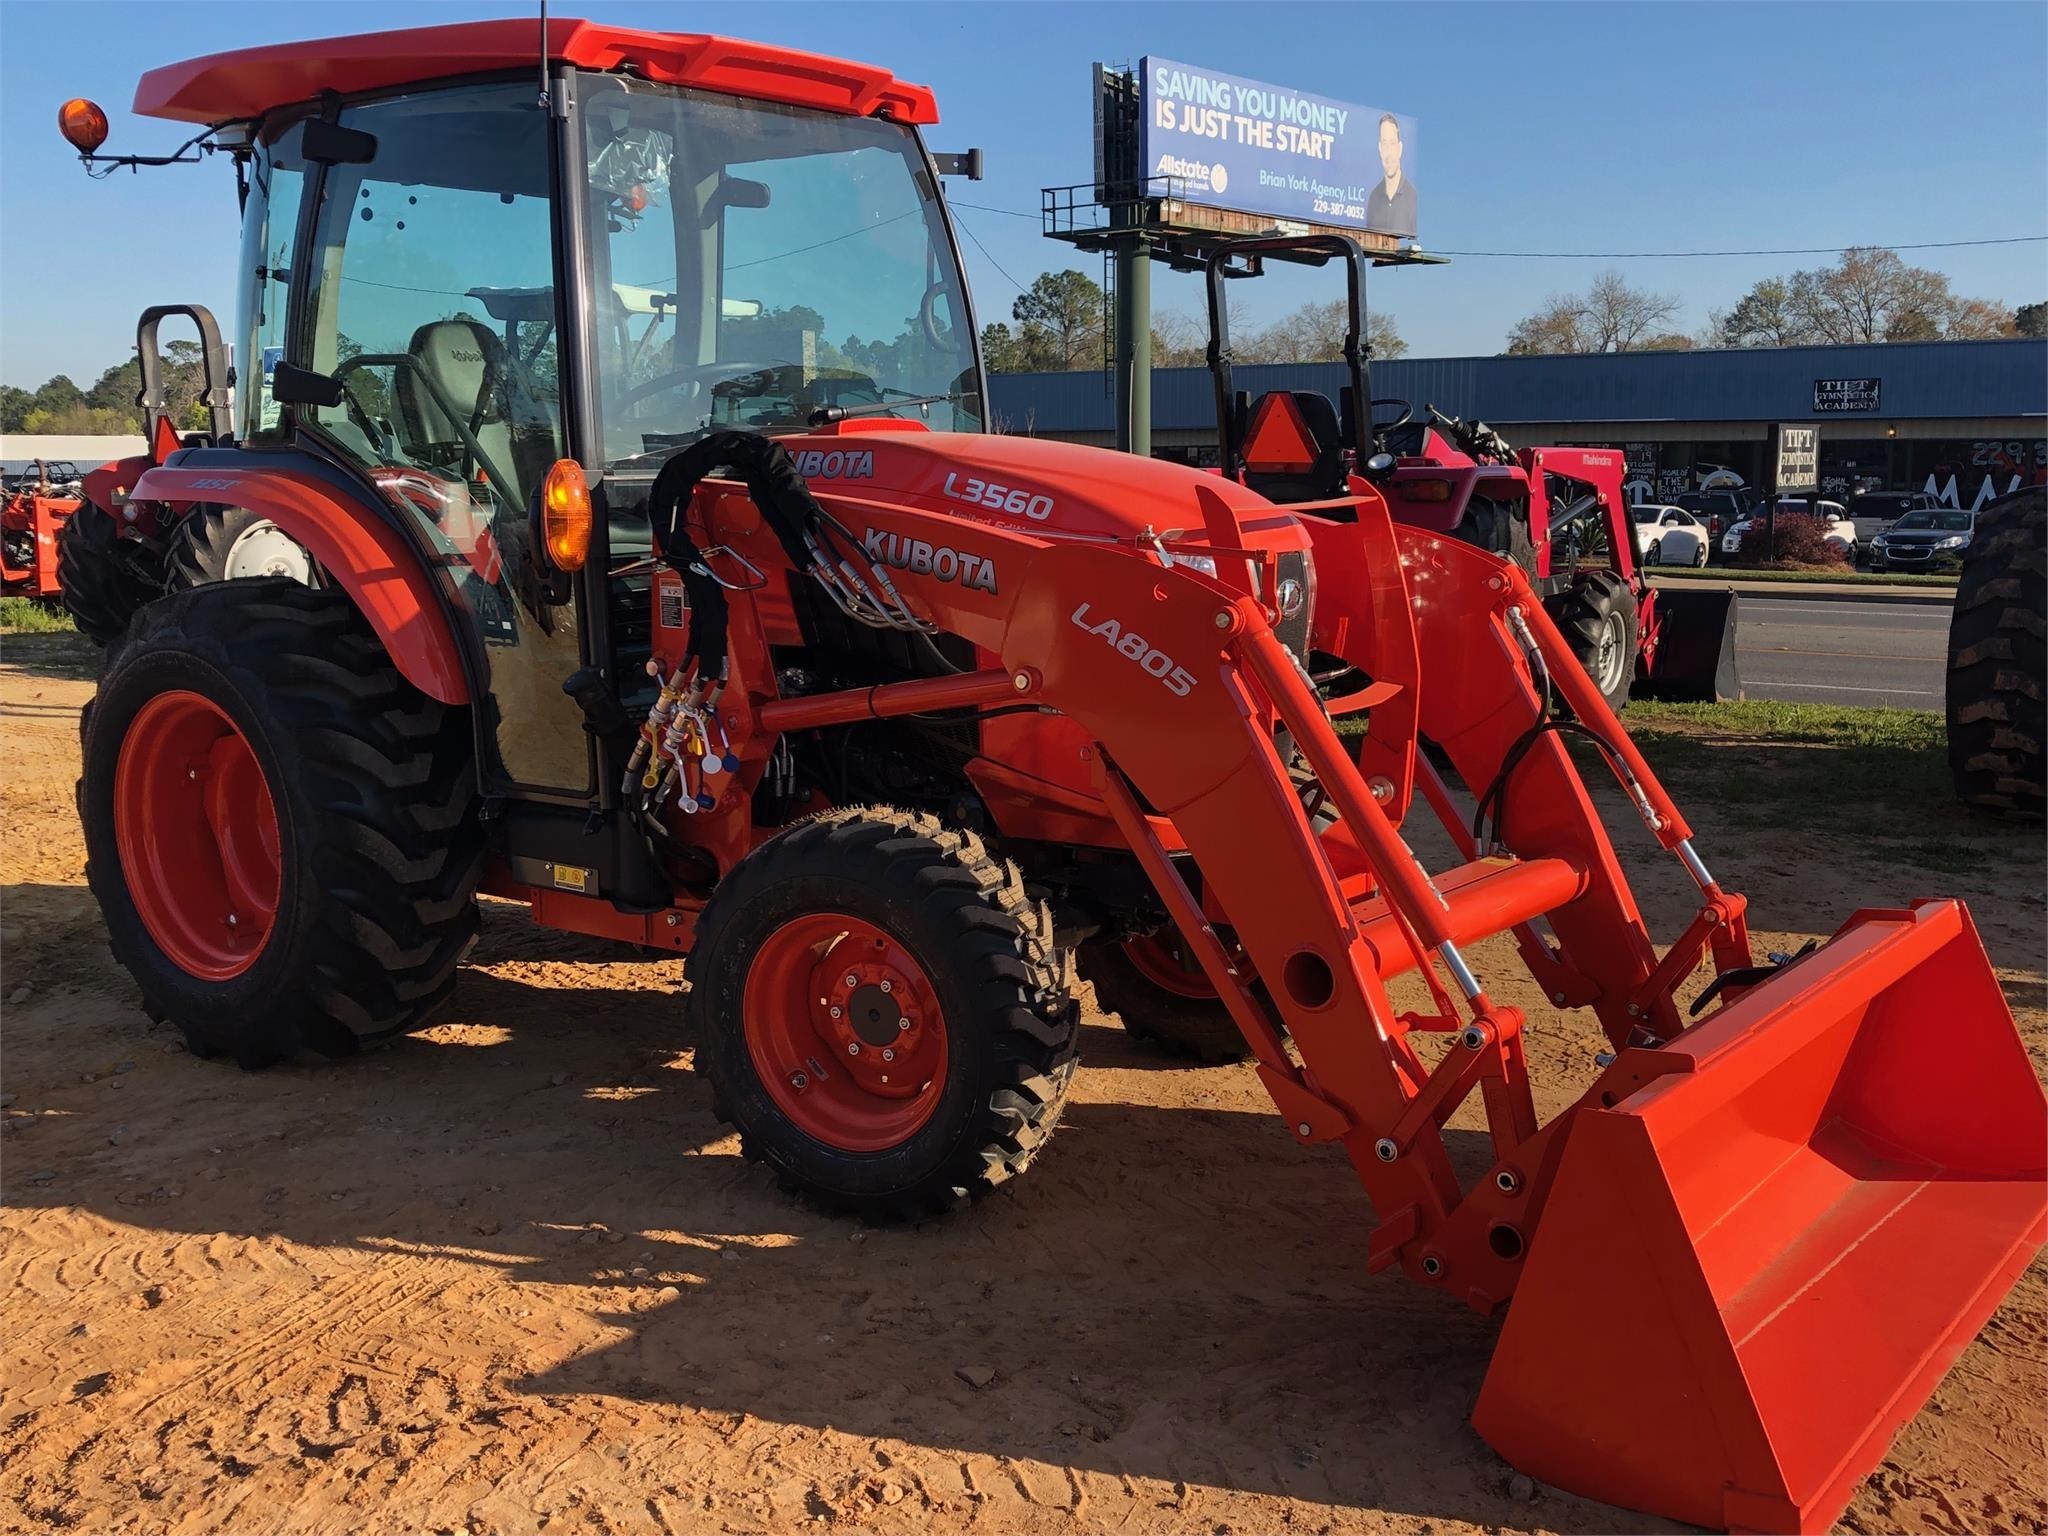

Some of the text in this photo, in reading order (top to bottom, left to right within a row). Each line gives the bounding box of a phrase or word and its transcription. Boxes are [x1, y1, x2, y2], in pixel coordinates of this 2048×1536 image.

[1156, 67, 1348, 135] SAVING YOU MONEY
[1156, 99, 1334, 161] IS JUST THE START
[1156, 154, 1210, 180] Allstate
[1260, 169, 1365, 202] Brian York Agency, LLC
[1313, 199, 1365, 220] 229-387-0032
[1817, 402, 1875, 410] ACADEMY
[1786, 429, 1813, 448] TIFT
[787, 451, 874, 478] UBOTA
[1972, 441, 2023, 465] 229
[1778, 472, 1816, 488] ACADEMY
[943, 472, 1055, 521] L3560
[864, 527, 998, 595] KUBOTA
[1071, 602, 1198, 697] LA805
